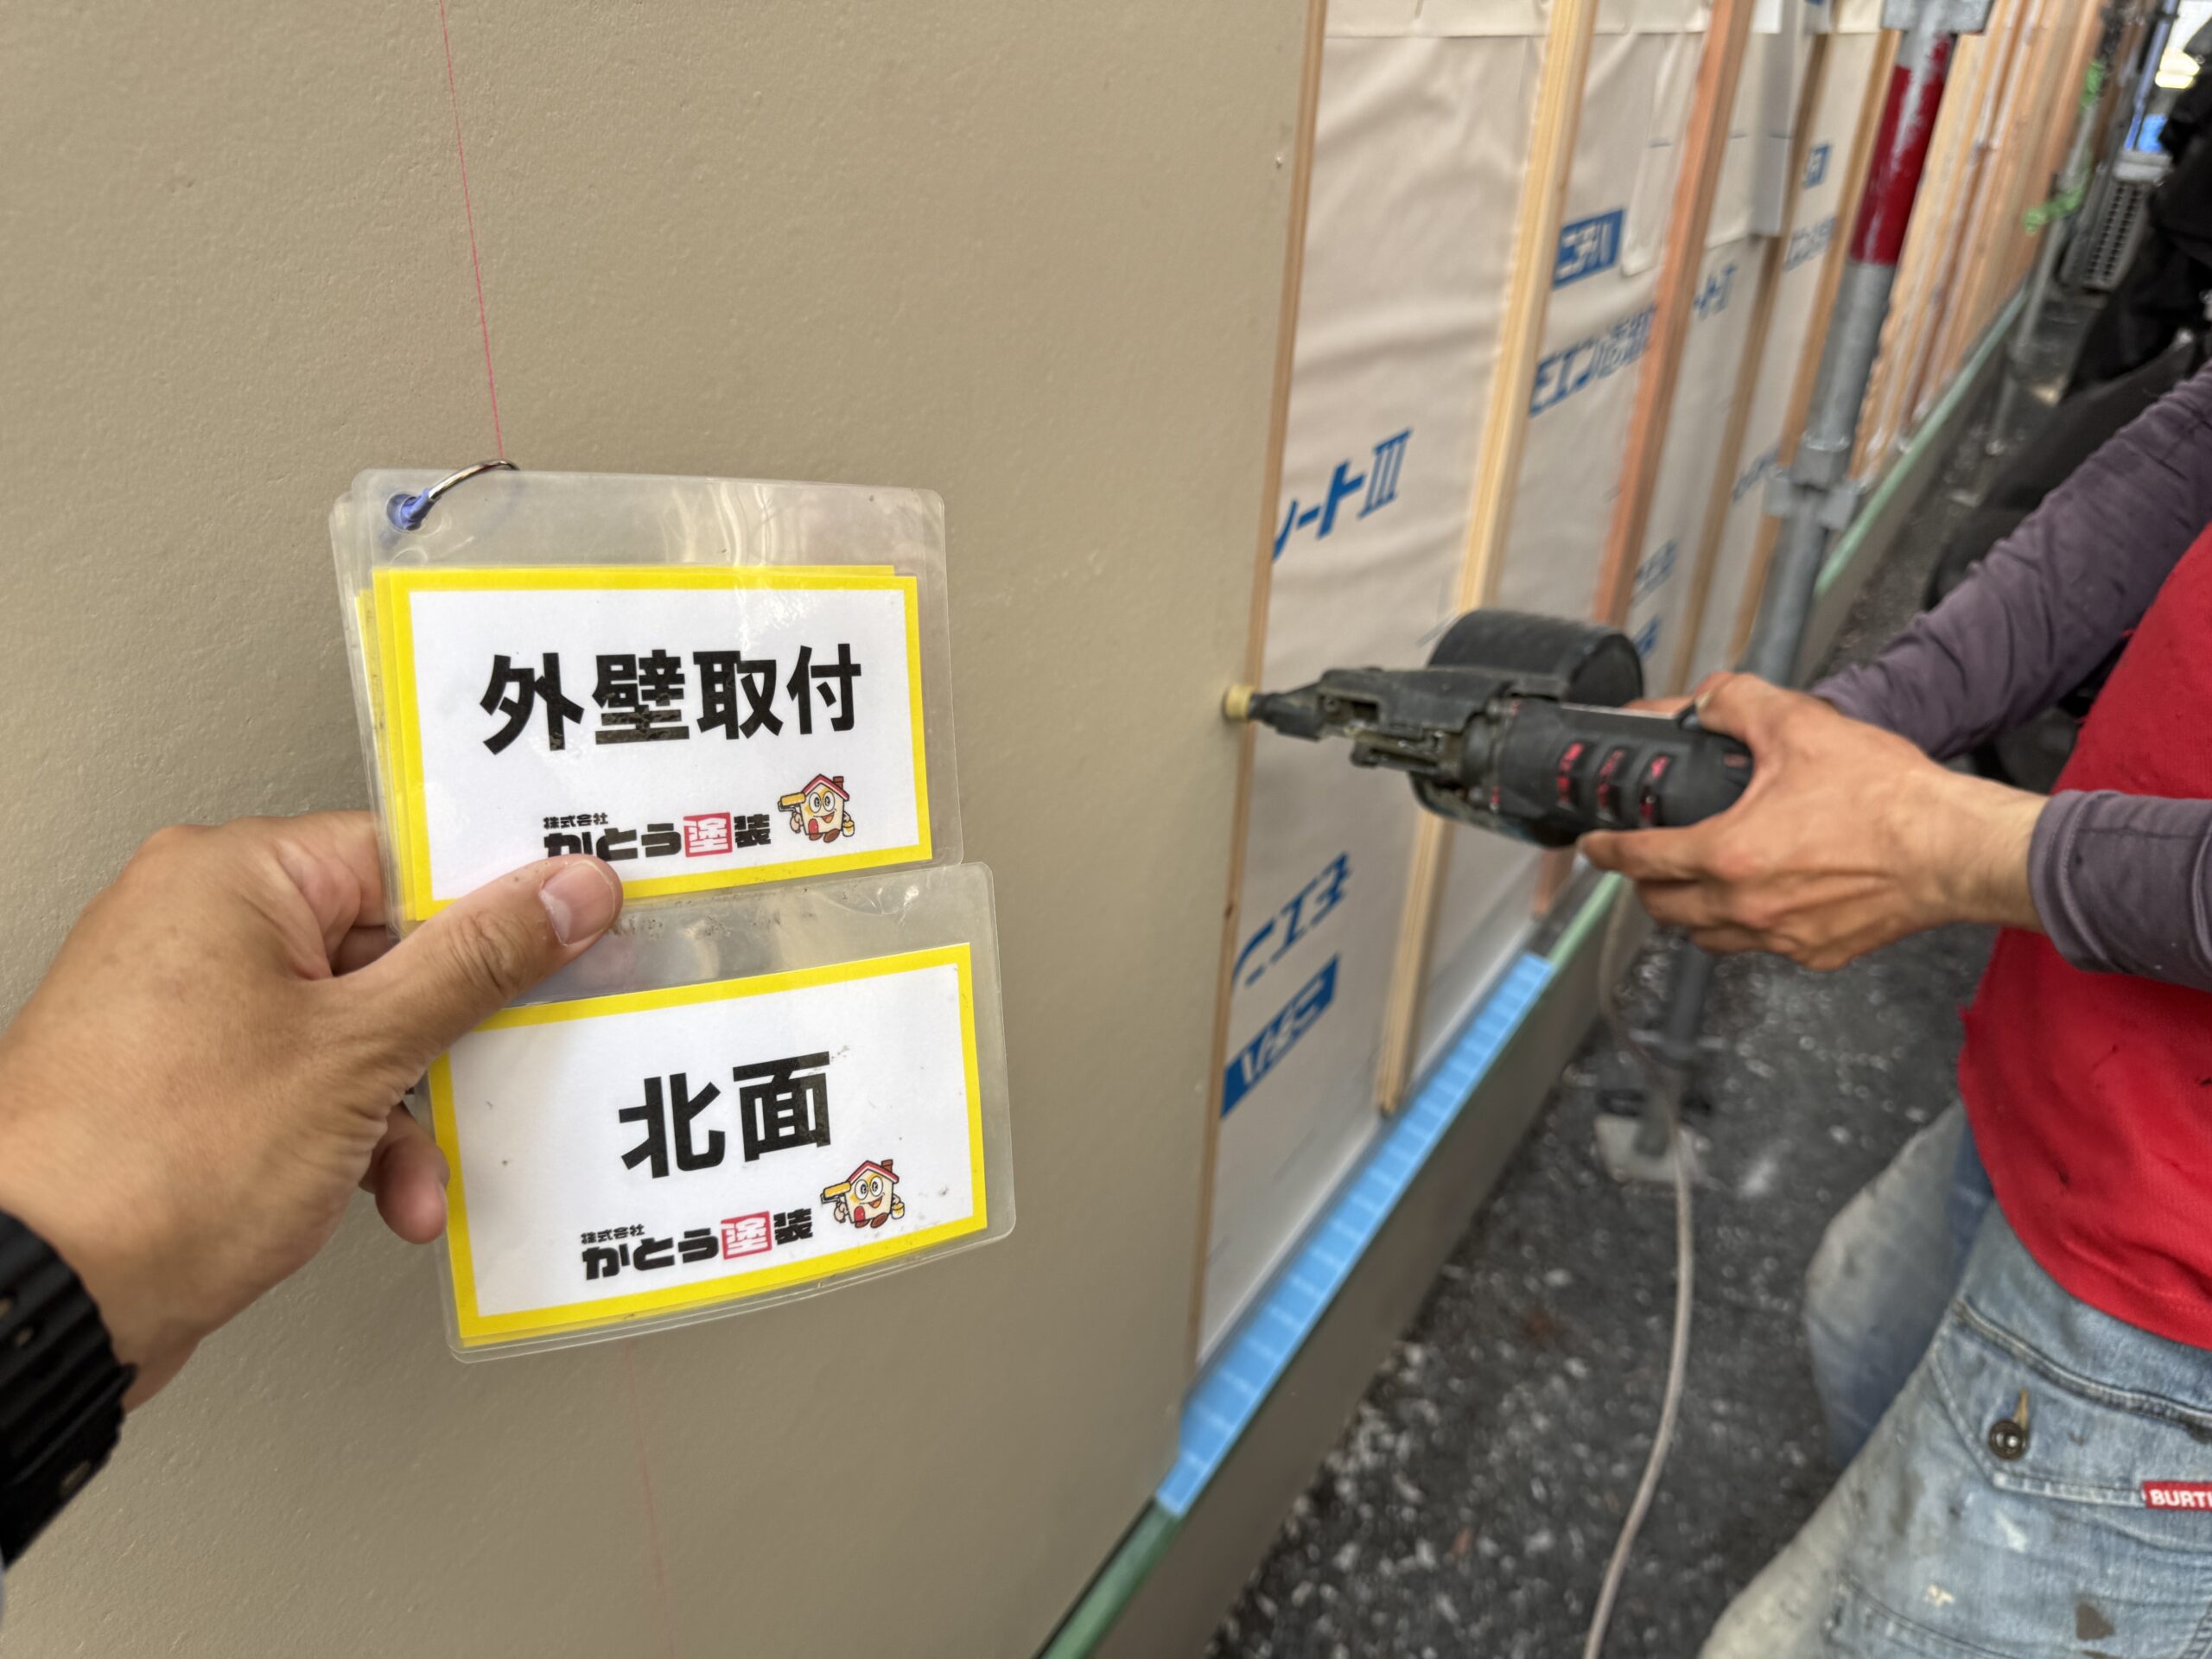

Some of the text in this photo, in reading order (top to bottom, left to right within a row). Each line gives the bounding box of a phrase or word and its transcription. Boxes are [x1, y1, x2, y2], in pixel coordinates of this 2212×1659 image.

[479, 642, 862, 755] 外壁取付
[543, 812, 608, 830] 株式会社
[543, 811, 772, 862] かとう塗装
[619, 1051, 831, 1179] 北面
[581, 1223, 645, 1245] 株式会社
[581, 1207, 814, 1281] かとう塗装
